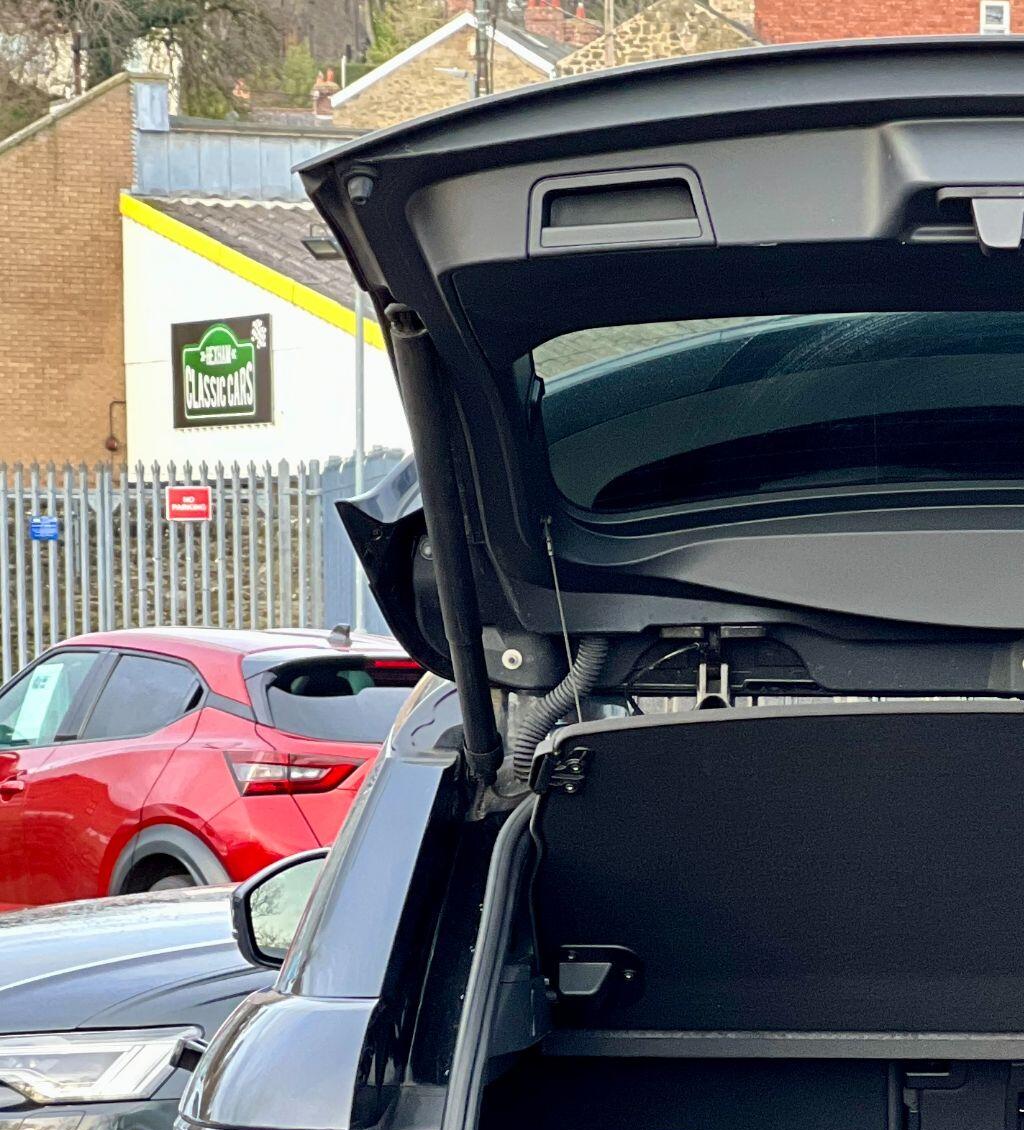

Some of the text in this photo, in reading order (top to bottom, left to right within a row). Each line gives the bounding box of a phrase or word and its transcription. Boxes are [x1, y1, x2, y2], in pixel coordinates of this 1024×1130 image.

[185, 362, 254, 409] CLASSIC CARS
[172, 503, 207, 511] PARKING
